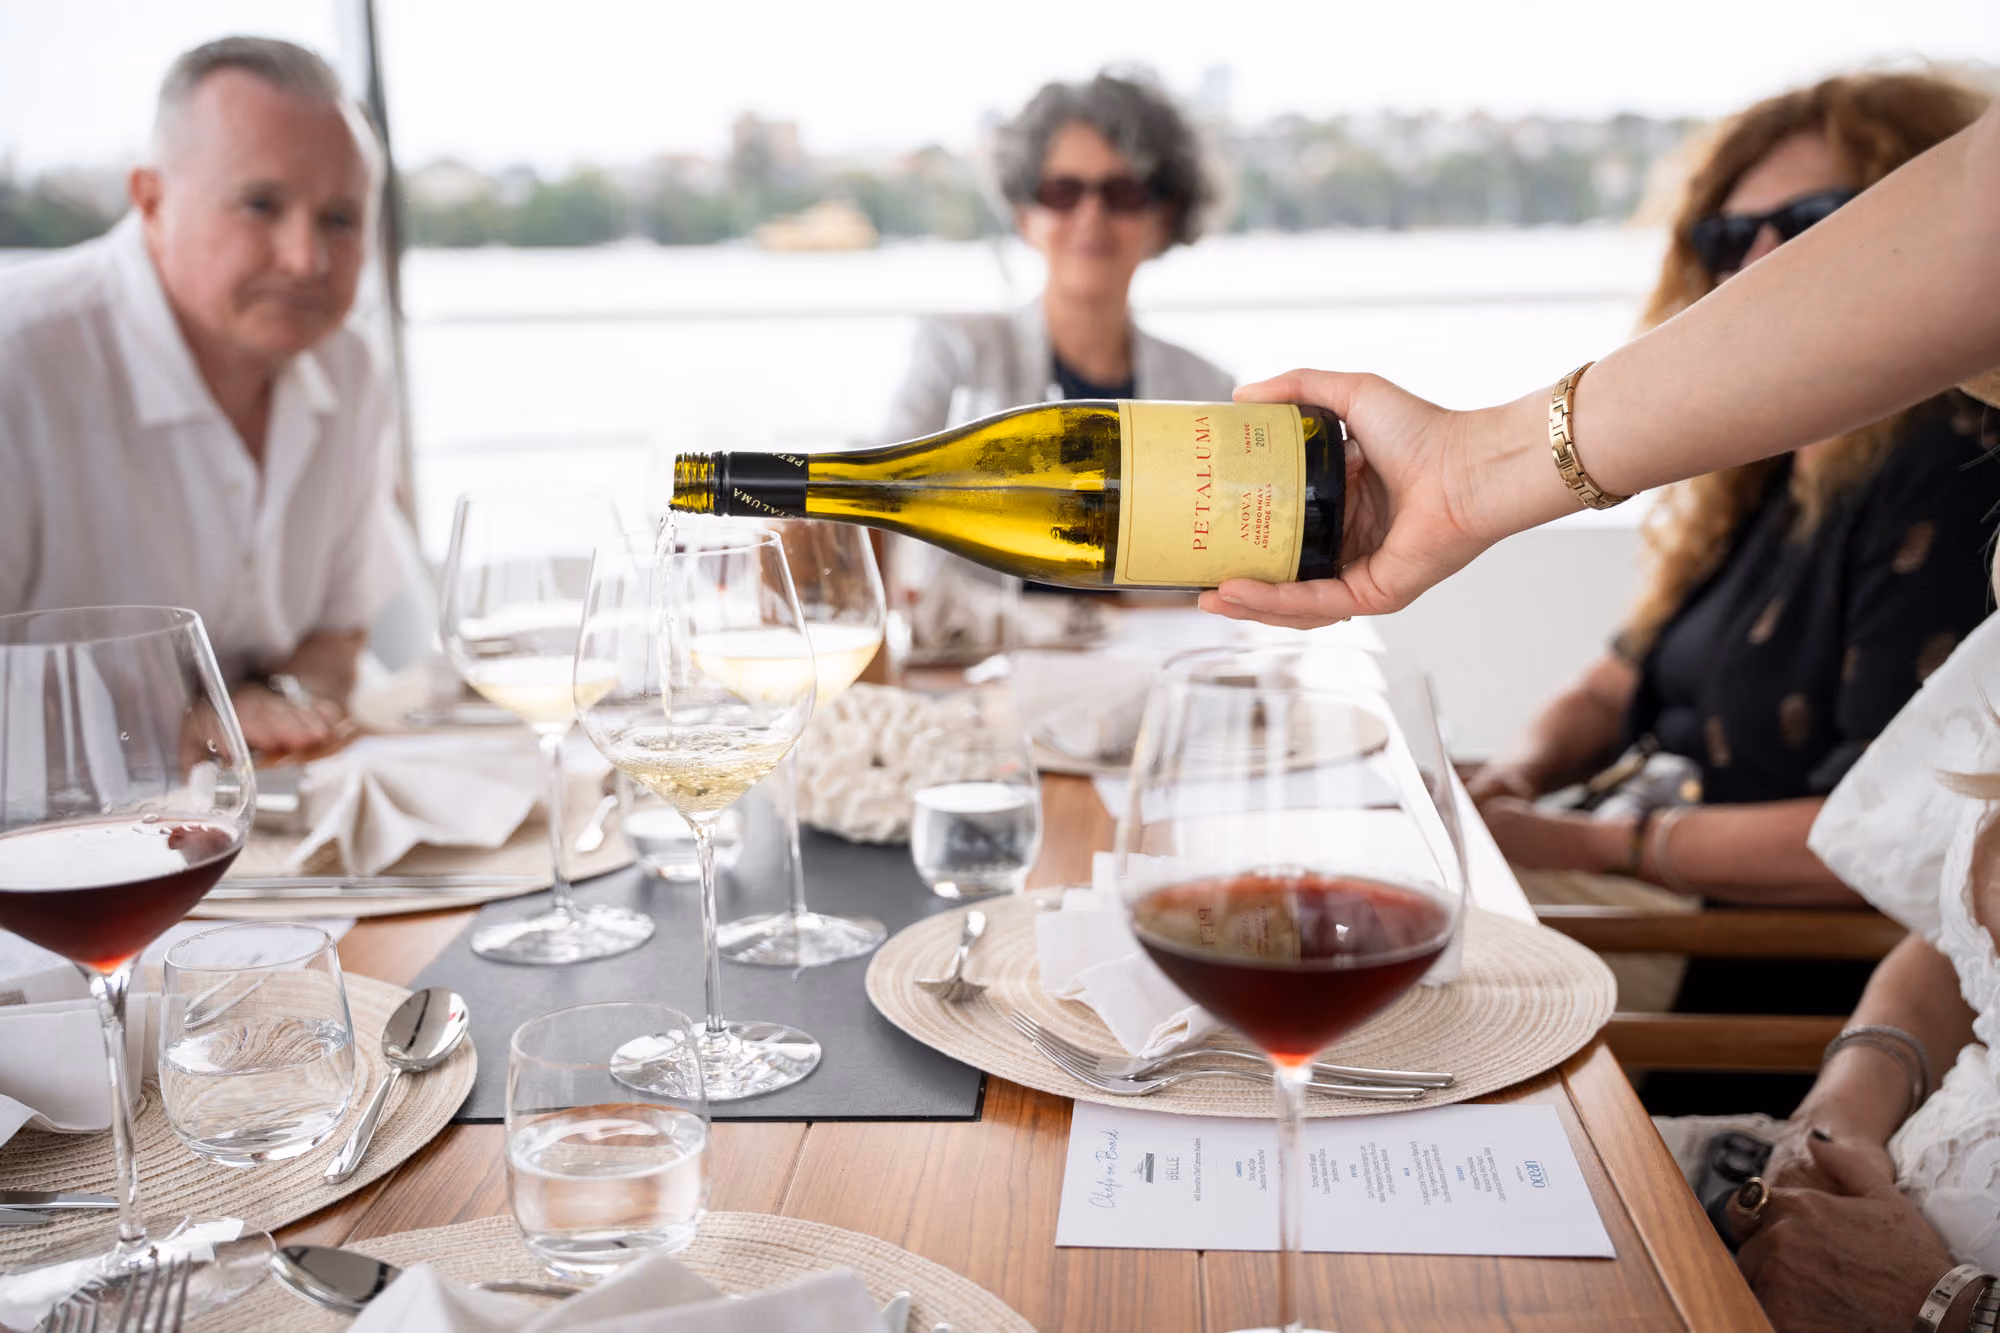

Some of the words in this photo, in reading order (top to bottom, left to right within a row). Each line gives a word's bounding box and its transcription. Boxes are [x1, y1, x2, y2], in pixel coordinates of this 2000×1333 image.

[1255, 427, 1265, 448] 2023
[1192, 416, 1212, 551] PETALUMA
[1265, 483, 1273, 507] HILLS
[1240, 492, 1252, 541] ANOVA
[1254, 488, 1264, 546] CHARDONNAY
[1262, 510, 1272, 550] ADELAIDE
[1166, 1156, 1180, 1181] BELLE
[1524, 1160, 1546, 1189] ocean
